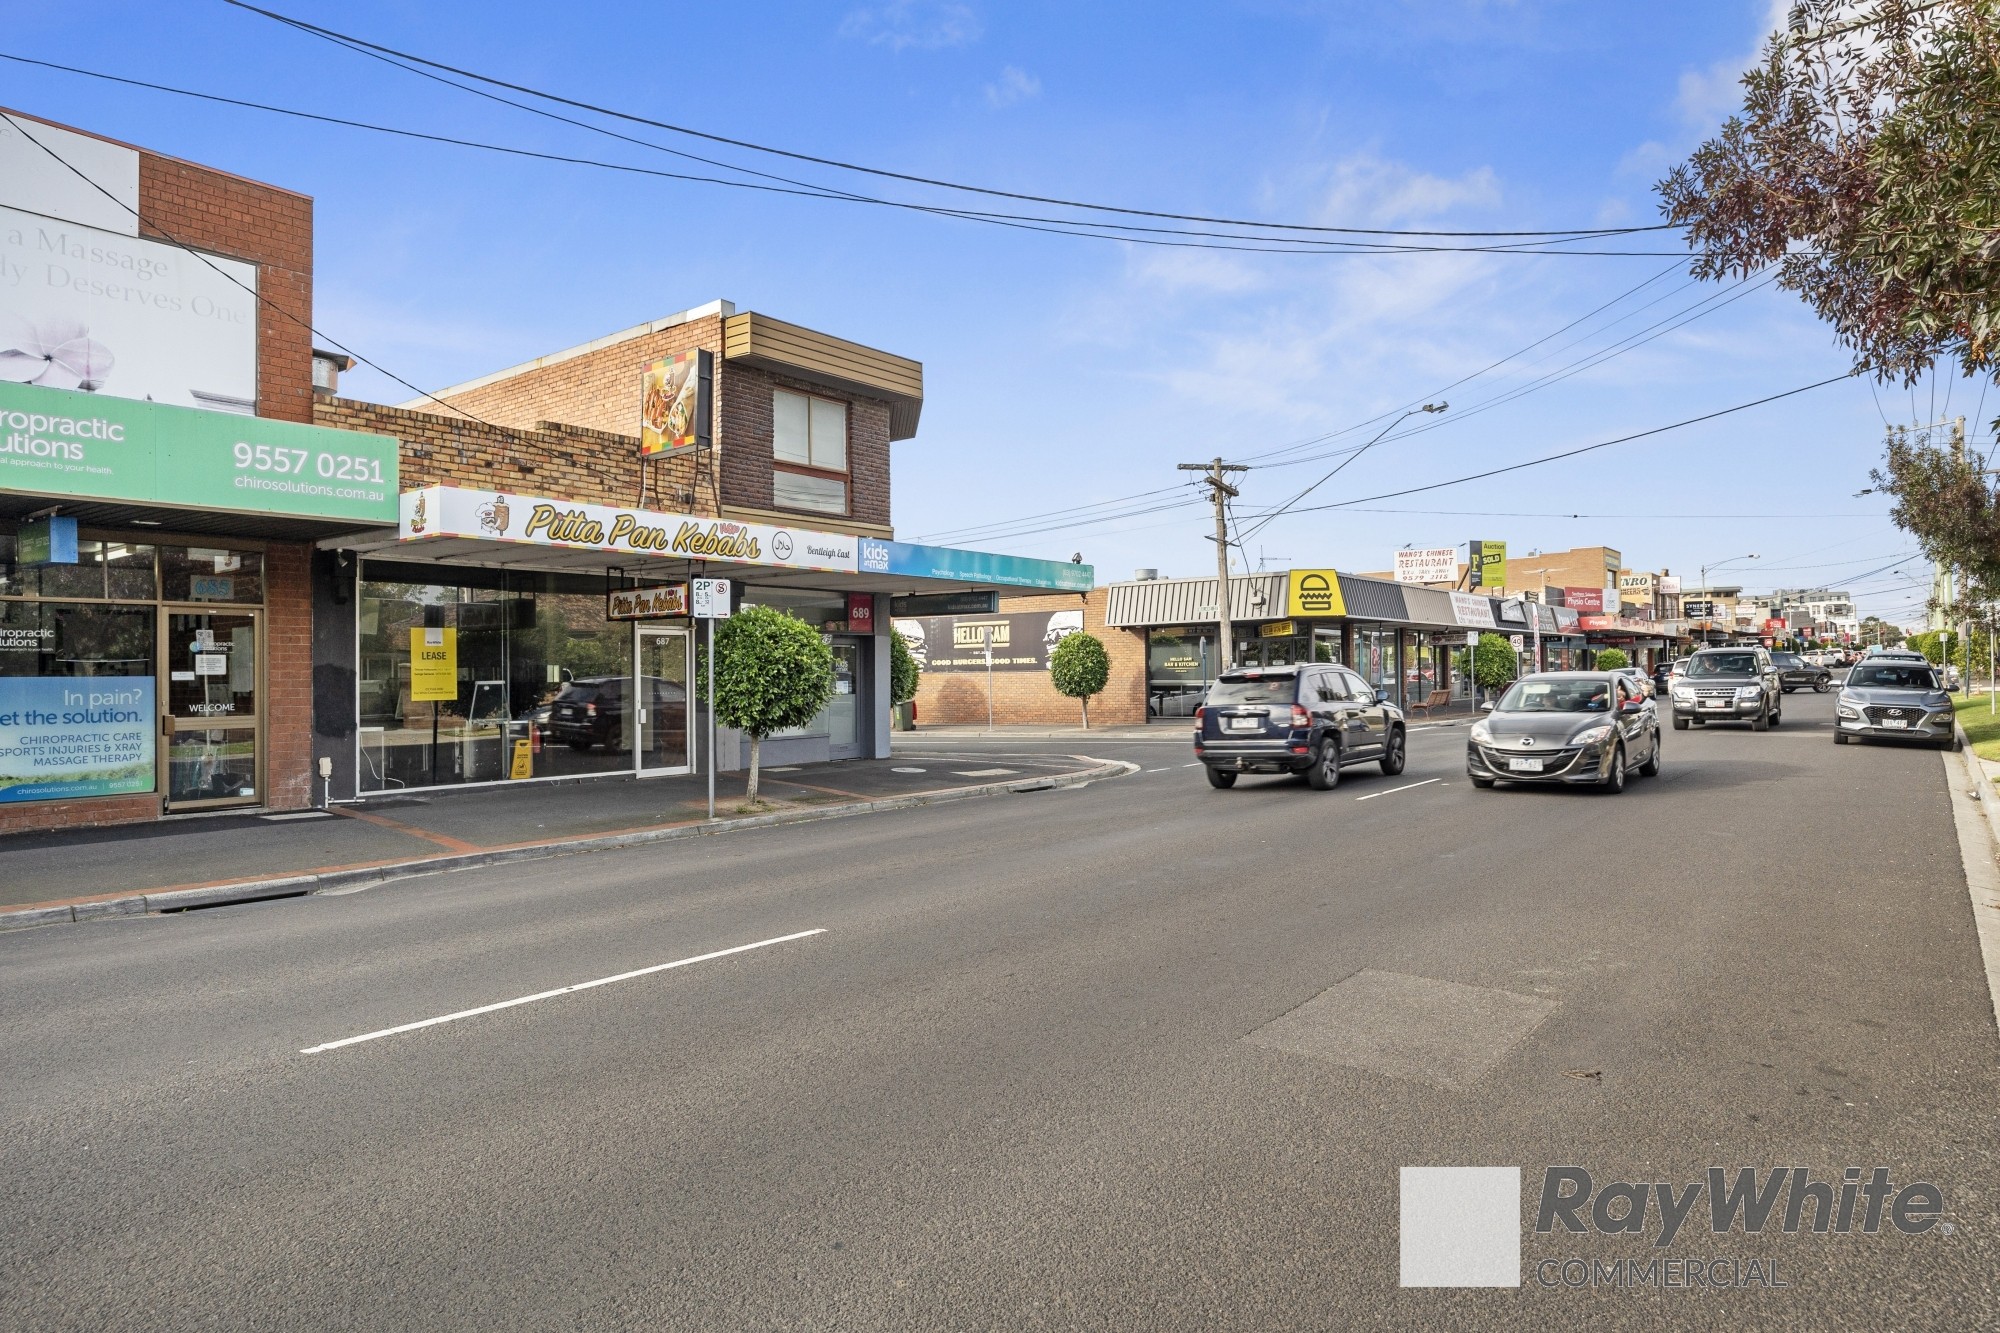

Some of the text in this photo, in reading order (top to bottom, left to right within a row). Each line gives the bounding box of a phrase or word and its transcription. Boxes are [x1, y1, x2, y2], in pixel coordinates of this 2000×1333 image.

[8, 228, 168, 281] a Massage
[46, 263, 182, 312] Deserves
[191, 295, 247, 324] One
[10, 459, 52, 469] approach
[54, 462, 63, 470] to
[65, 464, 84, 472] your
[233, 442, 384, 483] 9557 0251
[235, 475, 384, 501] chirosolutions.com.au
[525, 504, 761, 559] Pitta Pan Kebabs
[807, 545, 850, 560] Bentleigh East
[864, 543, 888, 561] kids
[870, 560, 888, 570] max
[1398, 558, 1454, 568] RESTAURANT
[1482, 555, 1500, 564] SOLD
[195, 579, 230, 596] 685
[696, 581, 710, 590] 2P
[1621, 577, 1648, 586] NRO
[634, 594, 651, 613] Pan
[652, 590, 682, 612] Kebabs
[1568, 598, 1584, 606] Physio
[1584, 598, 1600, 606] Centre
[852, 607, 870, 619] 689
[954, 626, 984, 644] HELLO
[1512, 636, 1520, 644] 40
[422, 652, 446, 660] LEASE
[64, 688, 142, 710] In pain?
[189, 704, 236, 712] WELCOME
[24, 710, 58, 726] the
[62, 708, 142, 724] solution.
[20, 732, 142, 746] CHIROPRACTIC CARE
[0, 742, 142, 758] SPORTS INJURIES & XRAY
[34, 753, 142, 766] MASSAGE THERAPY
[17, 784, 98, 795] chirosolutions.com.au
